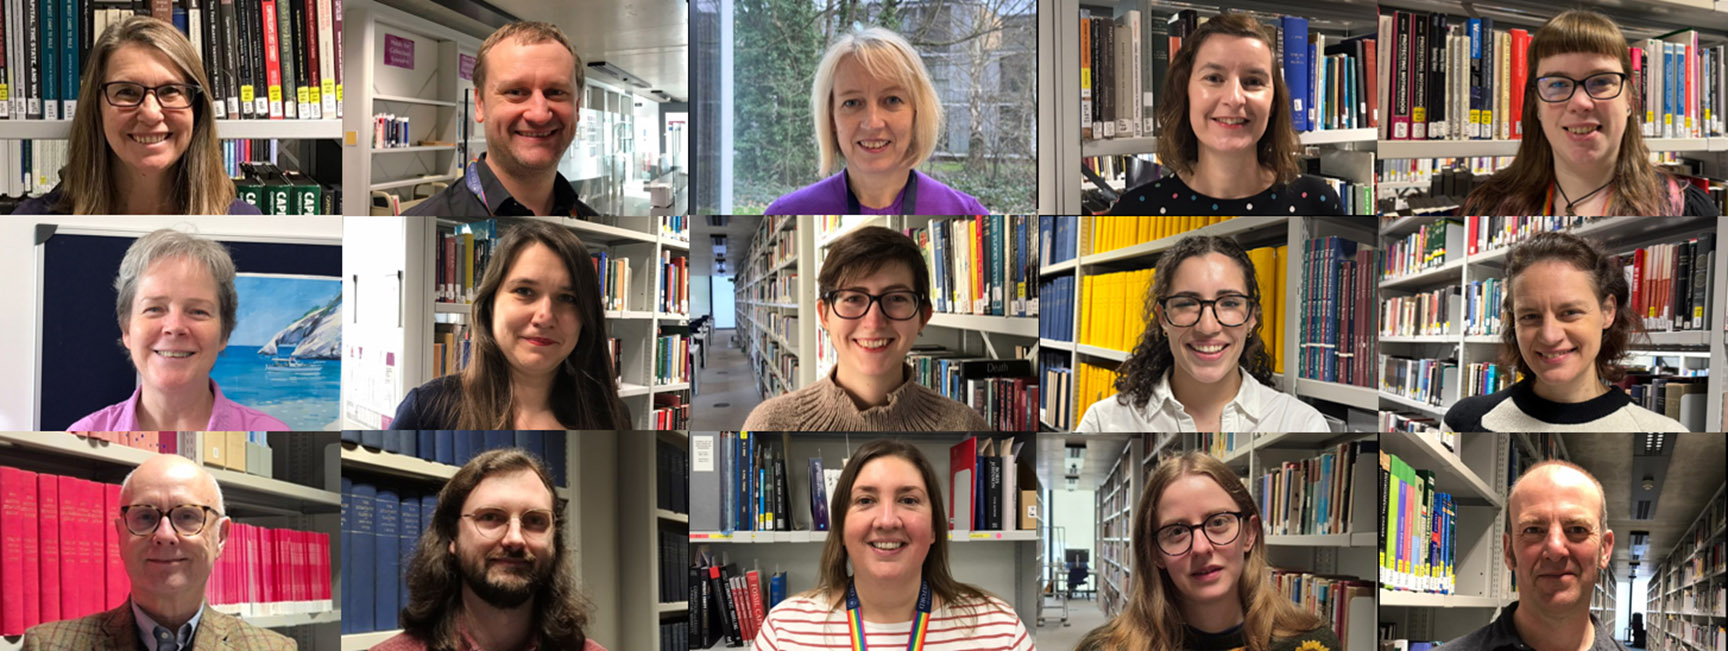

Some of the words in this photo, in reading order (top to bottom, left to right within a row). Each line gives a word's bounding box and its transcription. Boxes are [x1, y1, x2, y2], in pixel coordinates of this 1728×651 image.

[1399, 72, 1407, 114] MOTHERHOOD
[245, 192, 256, 205] CA
[276, 192, 287, 215] CAPI
[304, 192, 314, 215] CAPI
[987, 363, 1008, 373] Death
[751, 584, 760, 607] FOSSIL
